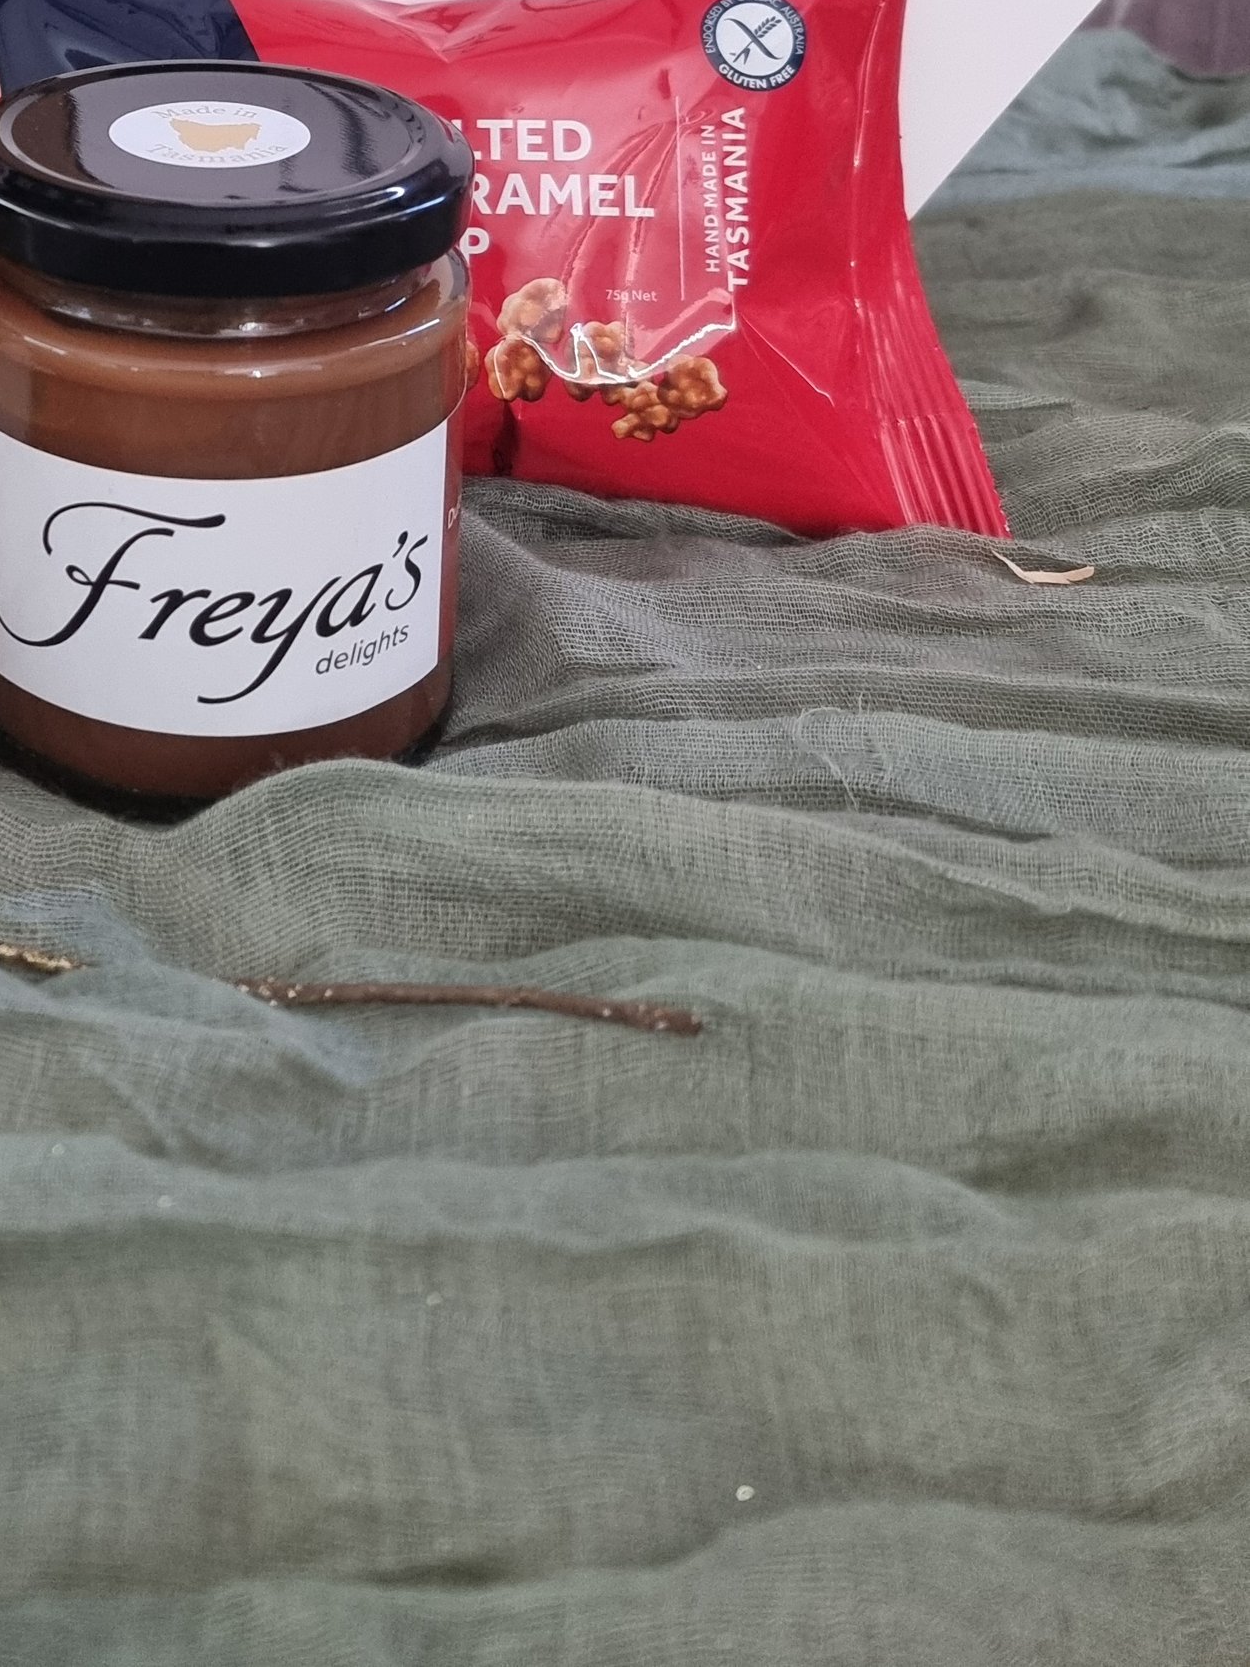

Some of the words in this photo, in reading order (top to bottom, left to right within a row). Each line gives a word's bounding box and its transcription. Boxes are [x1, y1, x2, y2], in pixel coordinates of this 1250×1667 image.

[702, 5, 724, 54] ENDORSED
[718, 63, 768, 89] GLUTEN
[769, 64, 796, 88] FREE
[700, 124, 716, 146] IN
[471, 172, 655, 218] RAMEL
[701, 150, 718, 209] MADE
[721, 107, 750, 293] TASMANIA
[704, 214, 721, 273] HAND
[606, 290, 630, 303] 75g
[632, 290, 658, 302] Net
[314, 622, 410, 676] delights
